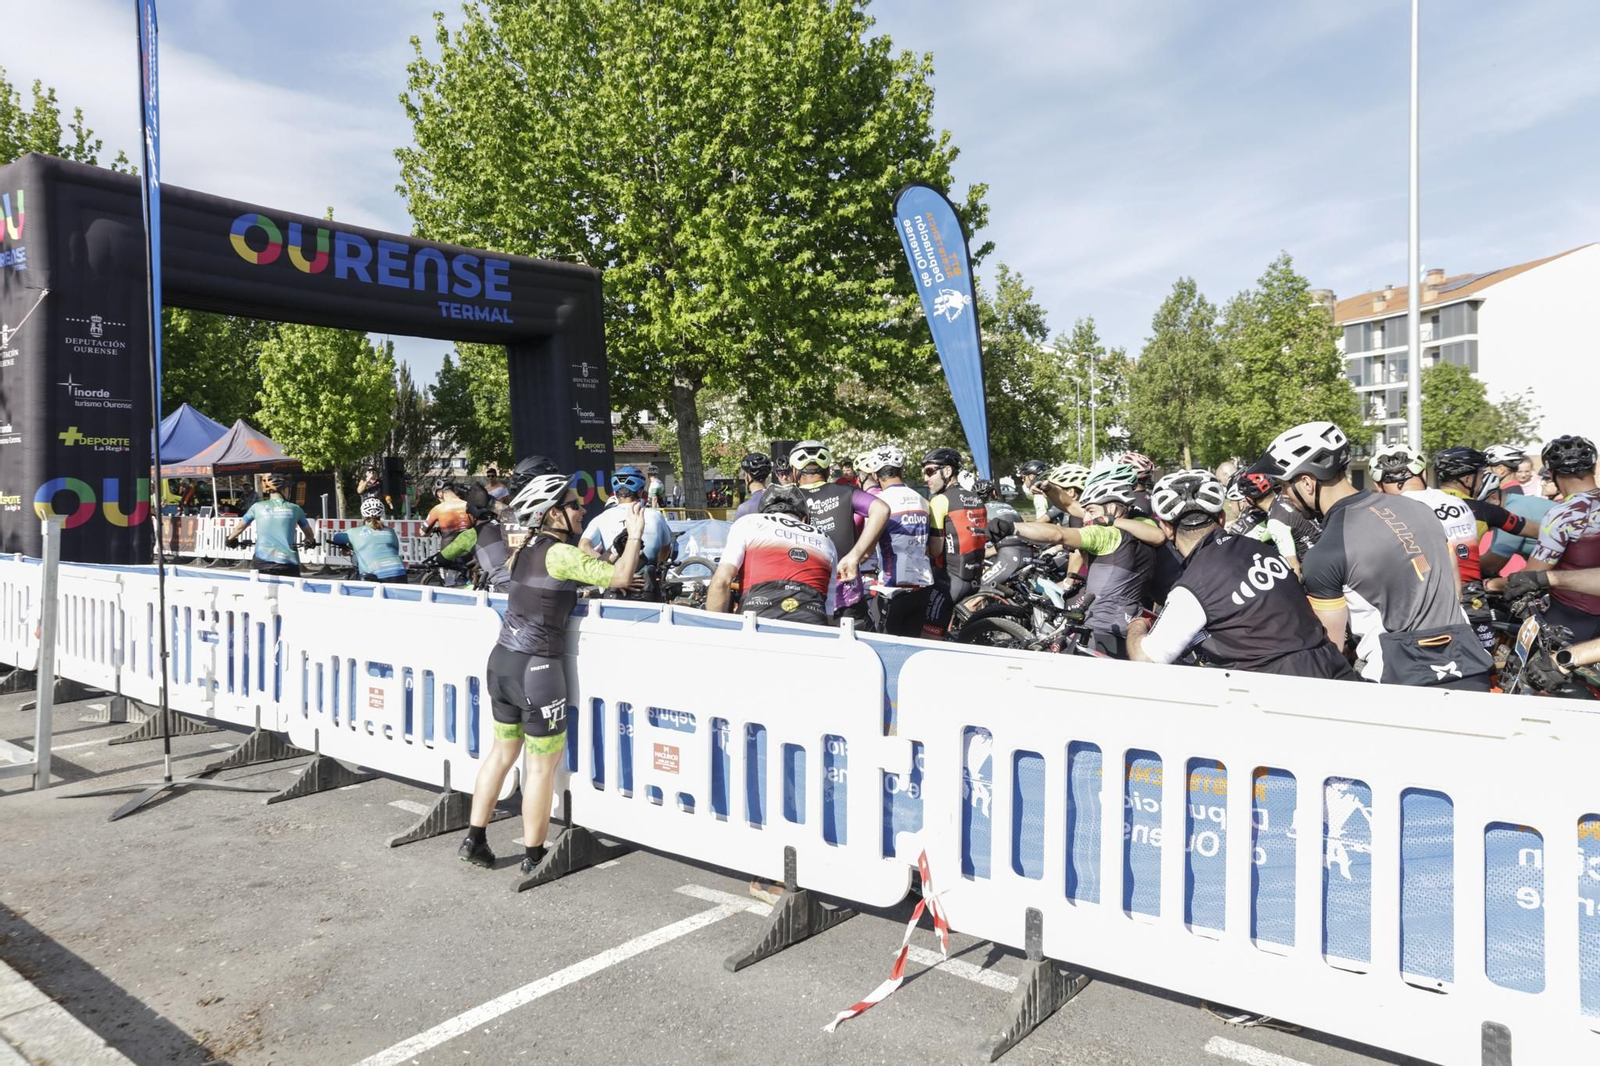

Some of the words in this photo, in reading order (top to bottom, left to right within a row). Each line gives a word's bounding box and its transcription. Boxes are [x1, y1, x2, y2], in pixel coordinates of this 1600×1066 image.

[229, 213, 512, 301] OURENSE
[438, 301, 514, 324] TERMAL
[65, 337, 127, 349] DEPUTACIÓN
[73, 345, 119, 356] OURENSE
[74, 387, 111, 398] inorde
[74, 400, 102, 408] turismo
[103, 401, 133, 409] Ourense
[33, 477, 150, 529] OU
[900, 513, 927, 525] Calvo
[1446, 523, 1473, 538] UTTER
[774, 528, 822, 549] CUTTER
